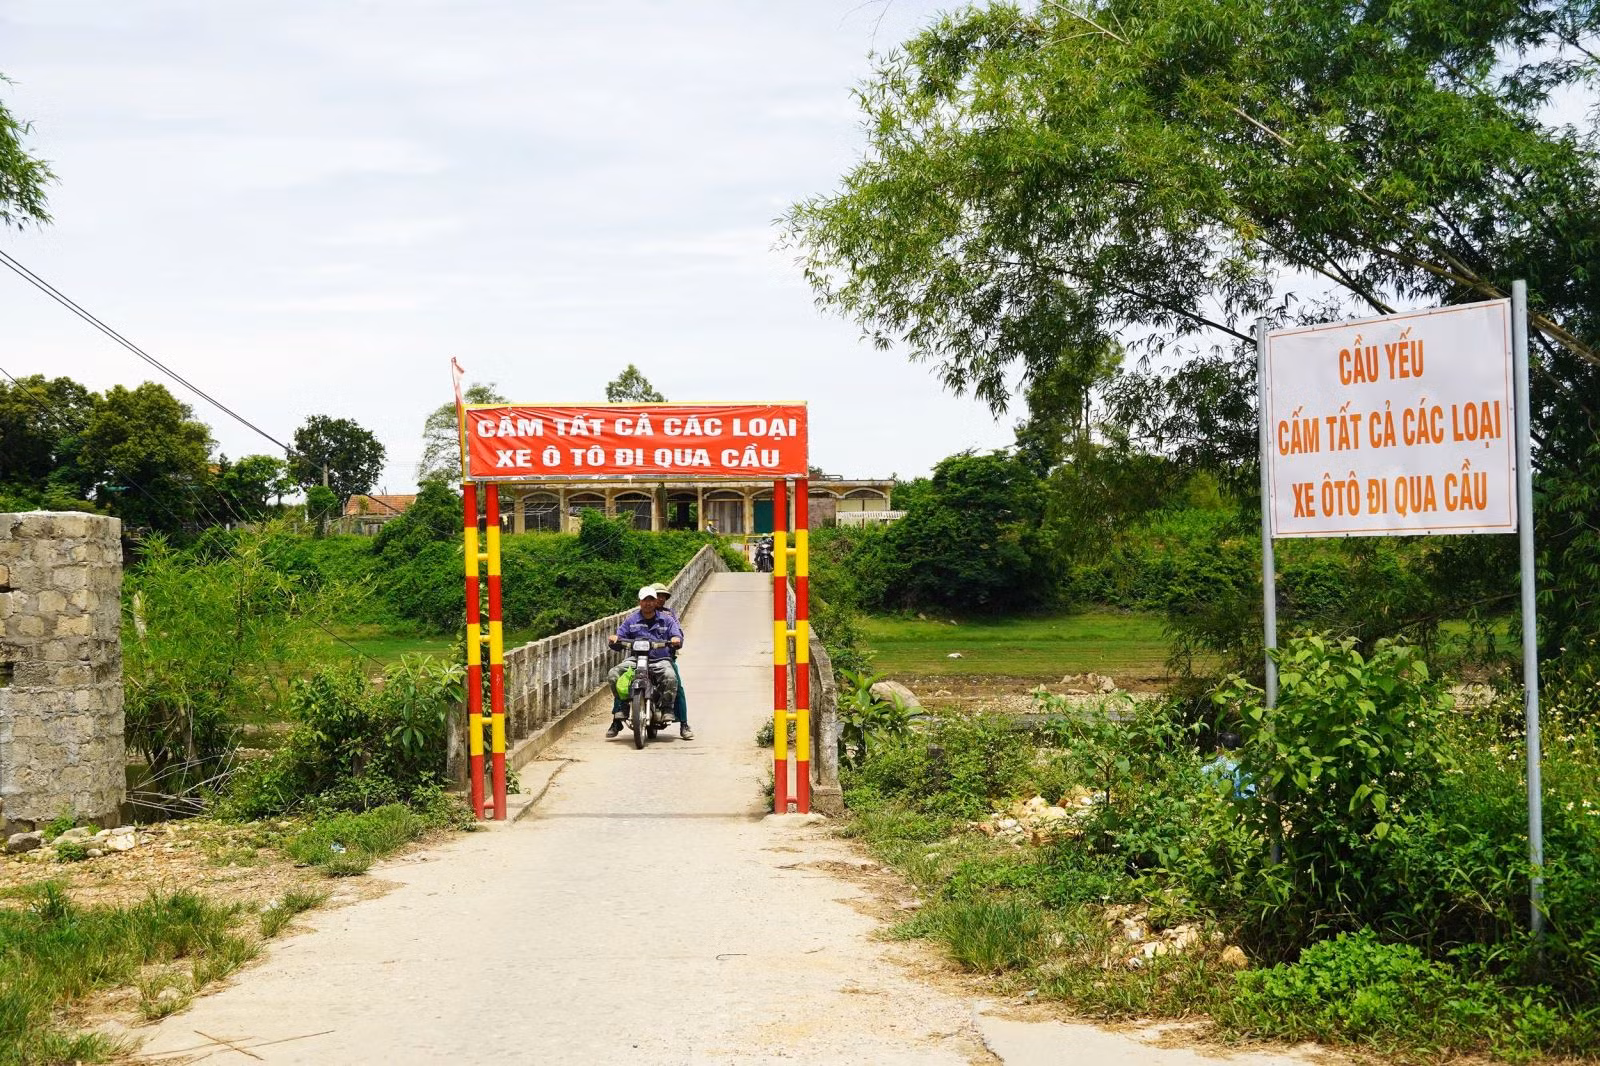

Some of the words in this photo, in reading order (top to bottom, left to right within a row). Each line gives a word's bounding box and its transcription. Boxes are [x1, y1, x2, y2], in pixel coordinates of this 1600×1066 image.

[1339, 334, 1378, 385] CẦU
[1385, 327, 1424, 380] YẾU
[477, 413, 544, 437] CẤM
[553, 413, 605, 436] TẤT
[615, 414, 654, 436] CẢ
[664, 414, 722, 436] CÁC
[733, 418, 796, 440] LOẠI
[1278, 406, 1320, 455] CẤM
[1326, 401, 1361, 451] TẤT
[1369, 400, 1396, 448] CẢ
[1402, 398, 1444, 446] CÁC
[1452, 400, 1501, 448] LOẠI
[496, 449, 532, 467] XE
[542, 446, 560, 466] Ô
[570, 445, 605, 466] TÔ
[615, 448, 643, 466] ĐI
[654, 448, 711, 468] QUA
[721, 443, 780, 468] CẦU
[1292, 482, 1316, 518] XE
[1322, 470, 1360, 517] ÔTÔ
[1367, 478, 1387, 515] ĐI
[1394, 475, 1437, 518] QUA
[1444, 459, 1487, 511] CẦU
